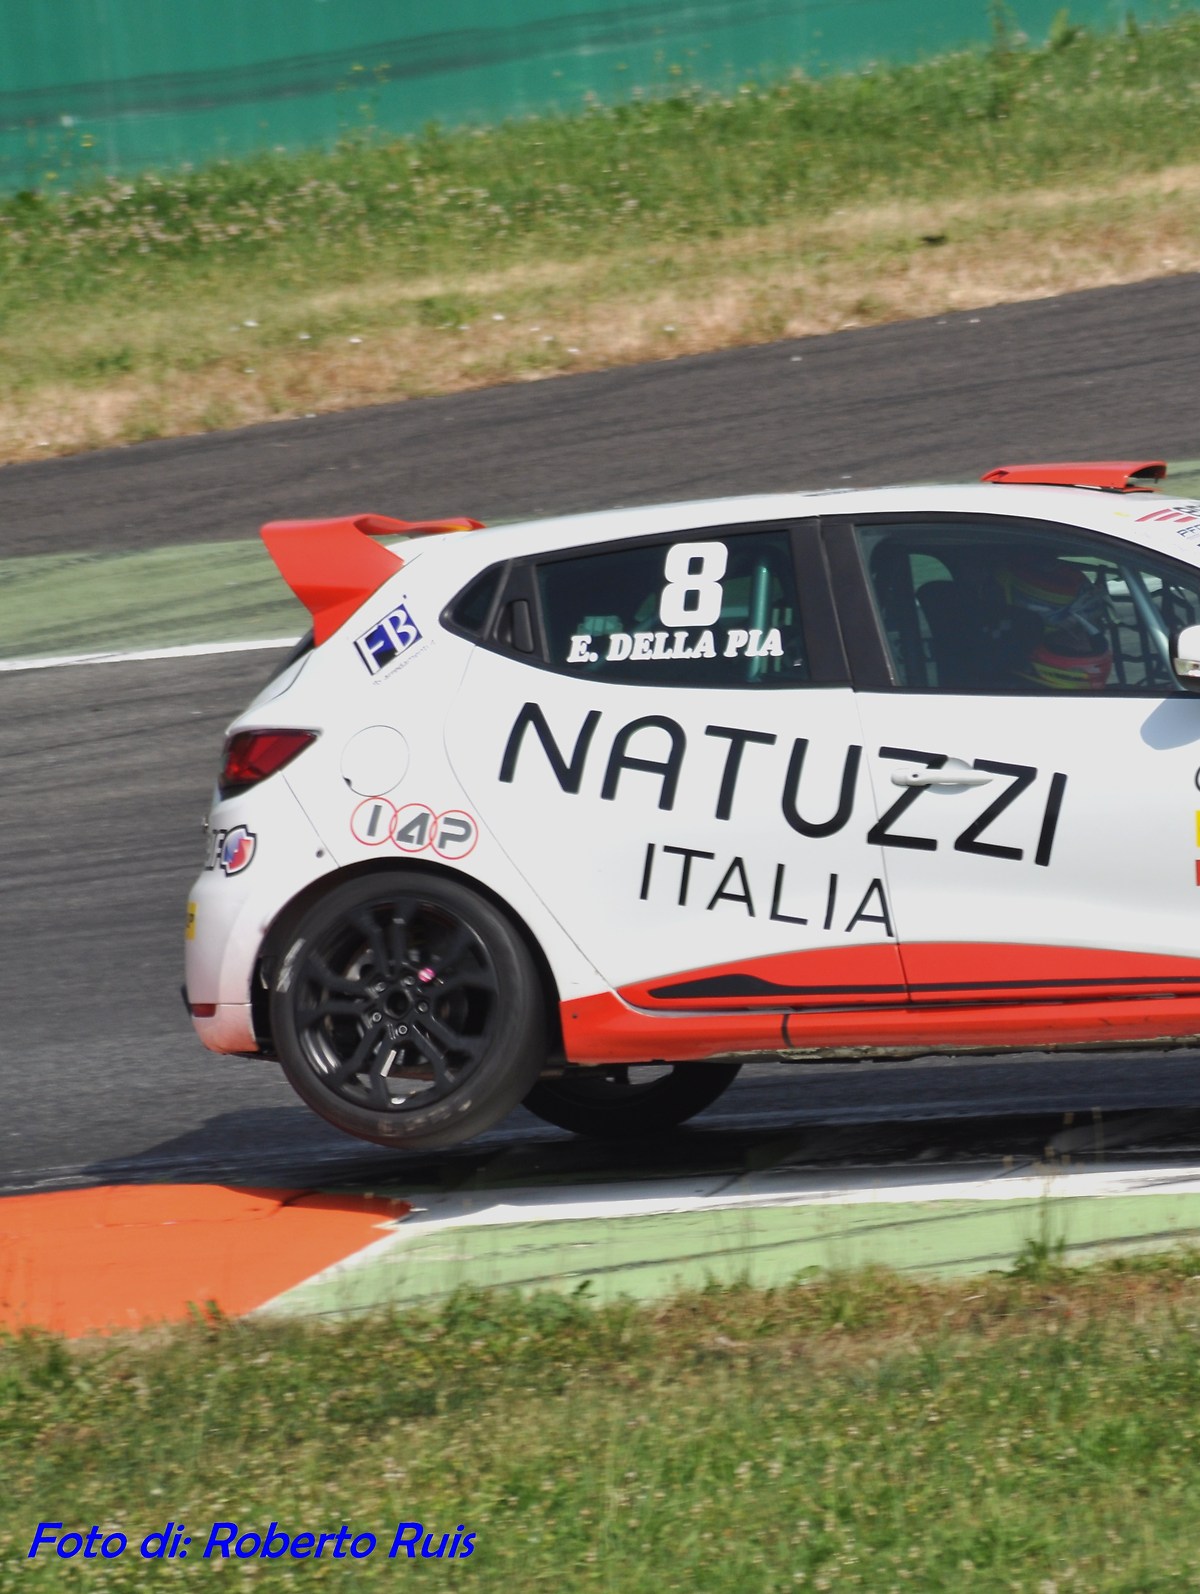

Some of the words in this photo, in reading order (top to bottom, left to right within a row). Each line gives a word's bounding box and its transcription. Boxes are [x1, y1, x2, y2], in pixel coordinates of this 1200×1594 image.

[660, 541, 728, 627] 8
[566, 634, 598, 662] E.
[606, 630, 717, 661] DELLA
[723, 628, 784, 657] PIA
[499, 702, 1067, 867] NATUZZI
[639, 843, 896, 937] ITALIA
